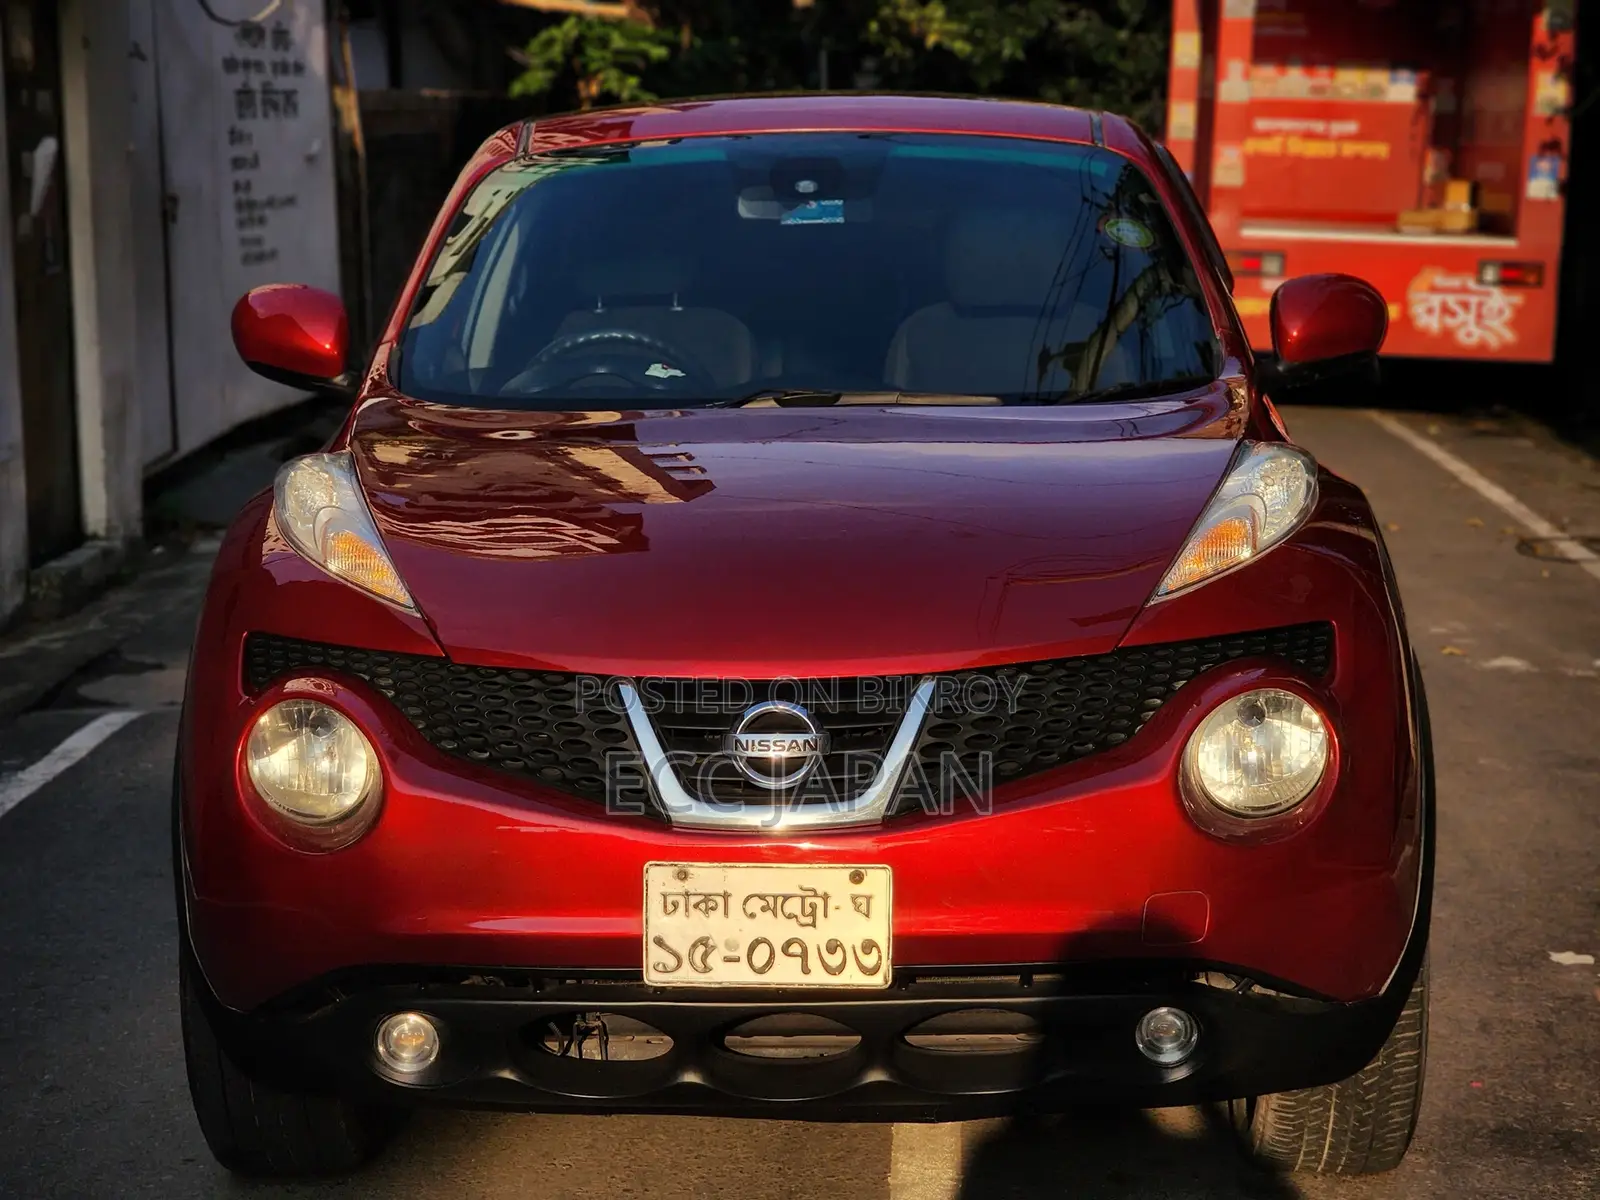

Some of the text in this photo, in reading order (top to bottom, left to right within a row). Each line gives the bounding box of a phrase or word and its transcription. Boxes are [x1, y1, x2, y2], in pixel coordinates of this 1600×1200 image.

[733, 737, 821, 753] NISSAN
[659, 889, 732, 919] ঢাকা
[652, 934, 884, 977] ১৫-০৭৩৩
